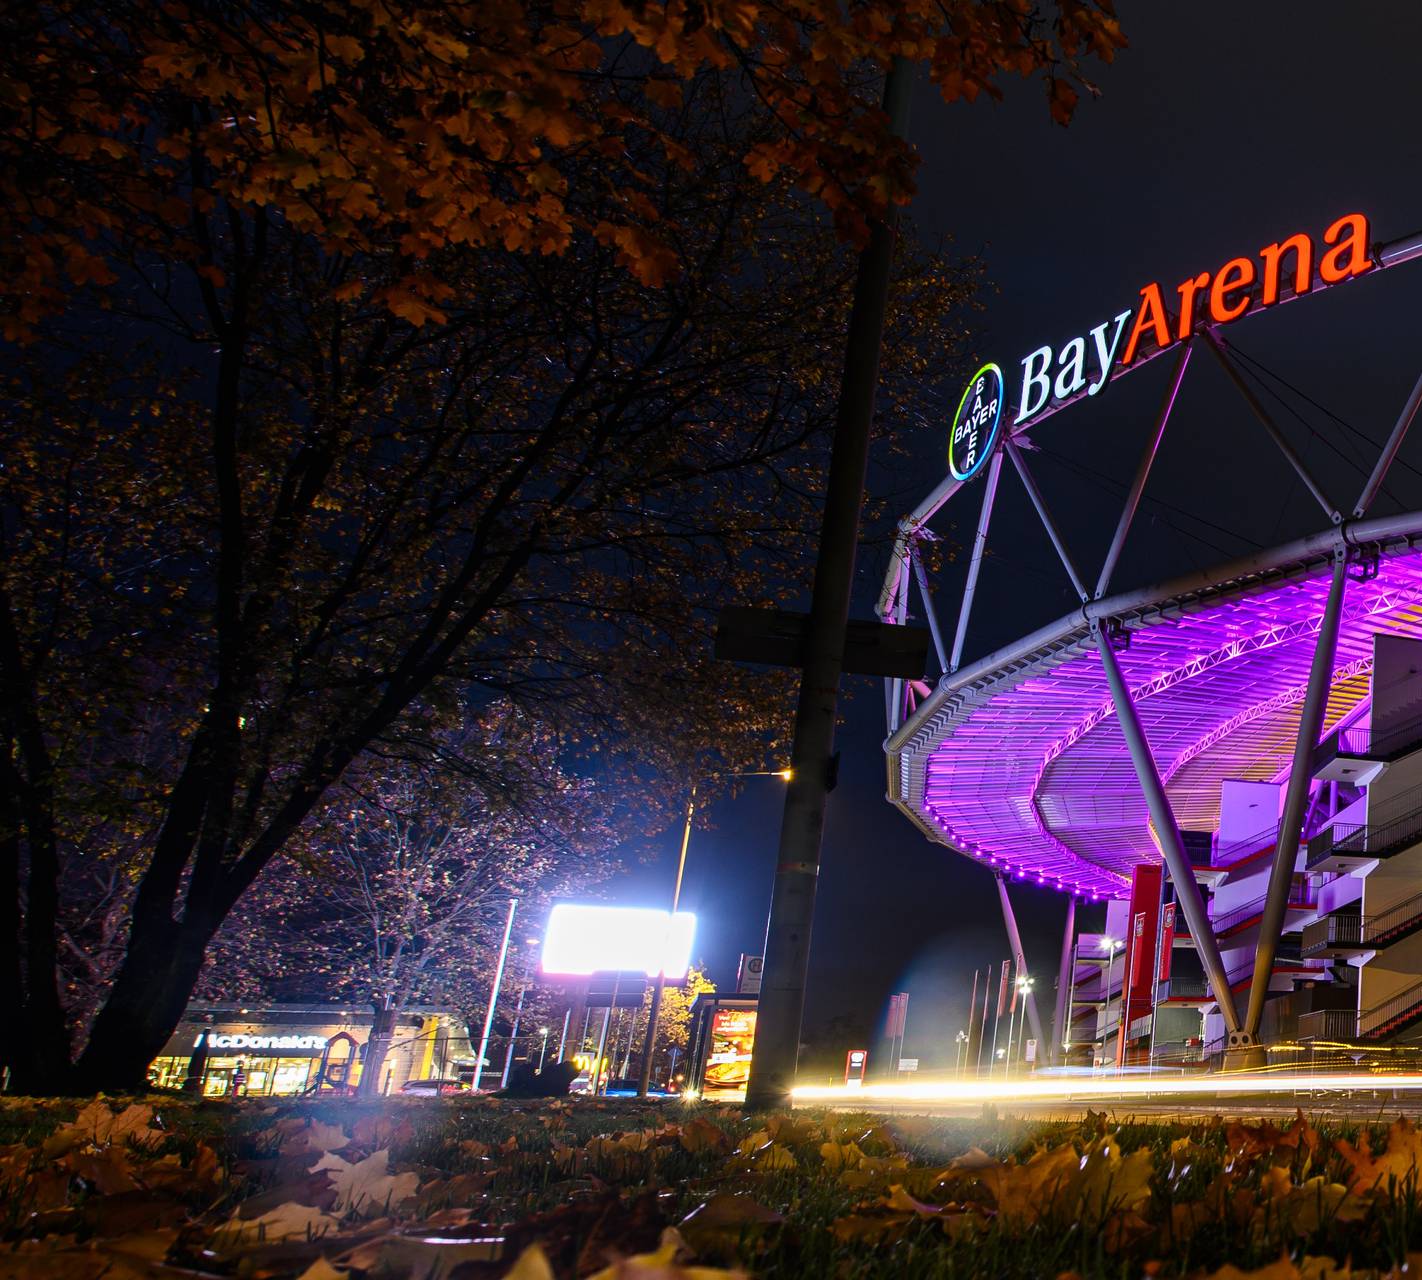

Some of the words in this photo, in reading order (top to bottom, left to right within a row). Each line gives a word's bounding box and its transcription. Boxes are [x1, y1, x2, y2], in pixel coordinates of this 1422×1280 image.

[1013, 212, 1373, 425] BayArena
[954, 399, 998, 443] BAYER
[965, 376, 985, 470] BAYER
[193, 1033, 329, 1050] McDonald's
